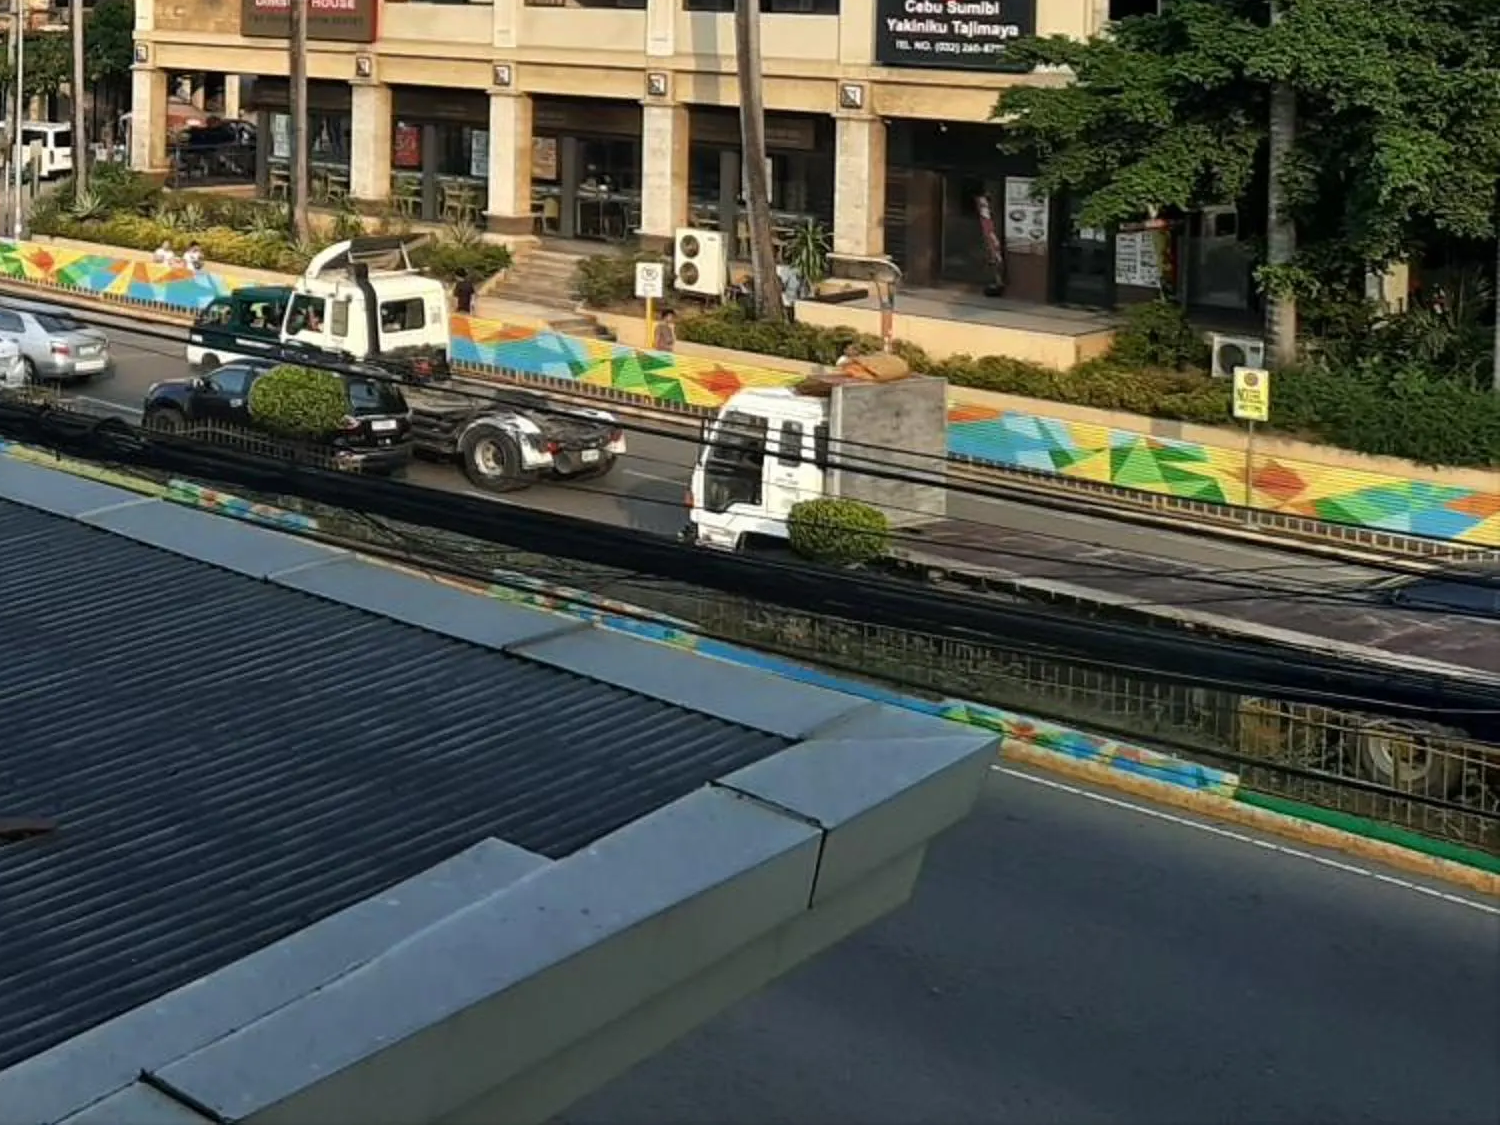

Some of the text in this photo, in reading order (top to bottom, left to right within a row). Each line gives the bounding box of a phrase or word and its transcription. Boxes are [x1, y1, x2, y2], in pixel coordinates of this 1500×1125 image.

[946, 0, 999, 15] Sumibi
[886, 17, 1019, 39] Yakiniku Tajimaya
